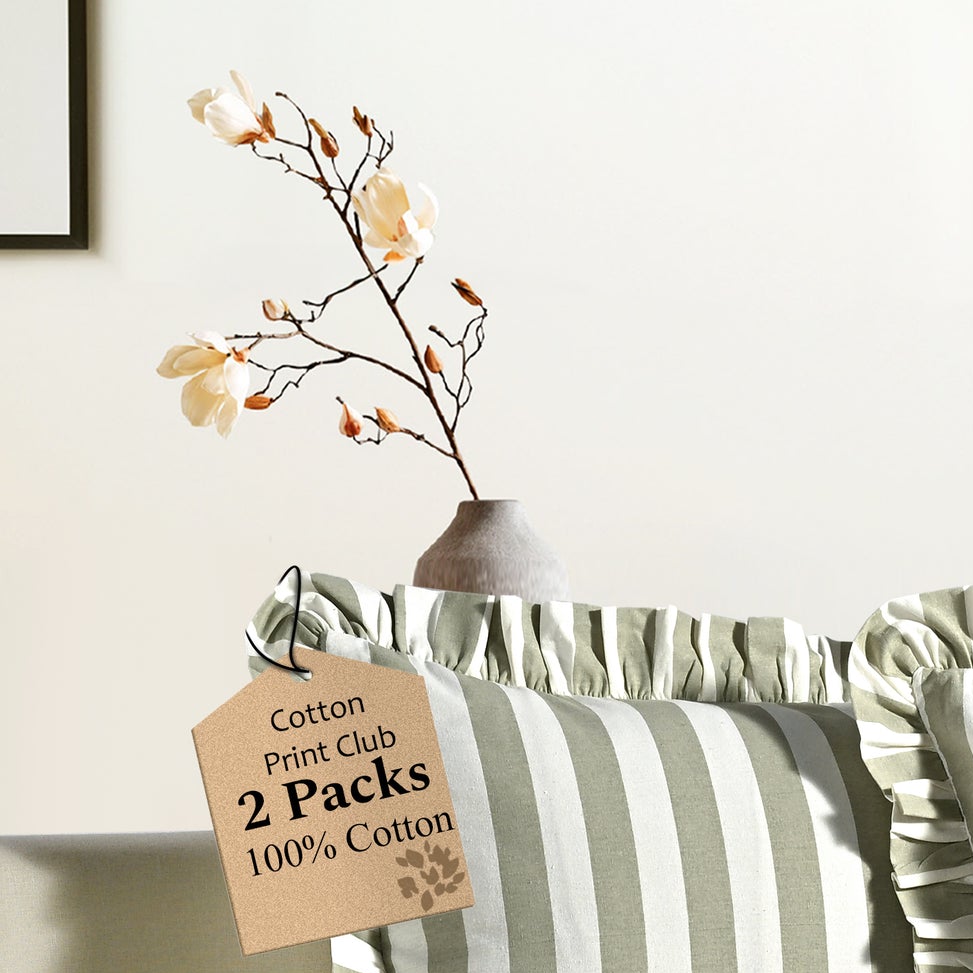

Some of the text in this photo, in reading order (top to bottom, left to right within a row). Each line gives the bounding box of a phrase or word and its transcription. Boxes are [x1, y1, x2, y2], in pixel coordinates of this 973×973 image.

[270, 696, 366, 732] Cotton
[263, 725, 397, 776] Print Club
[237, 755, 431, 832] 2 Packs
[246, 811, 456, 877] 100% Cotton
